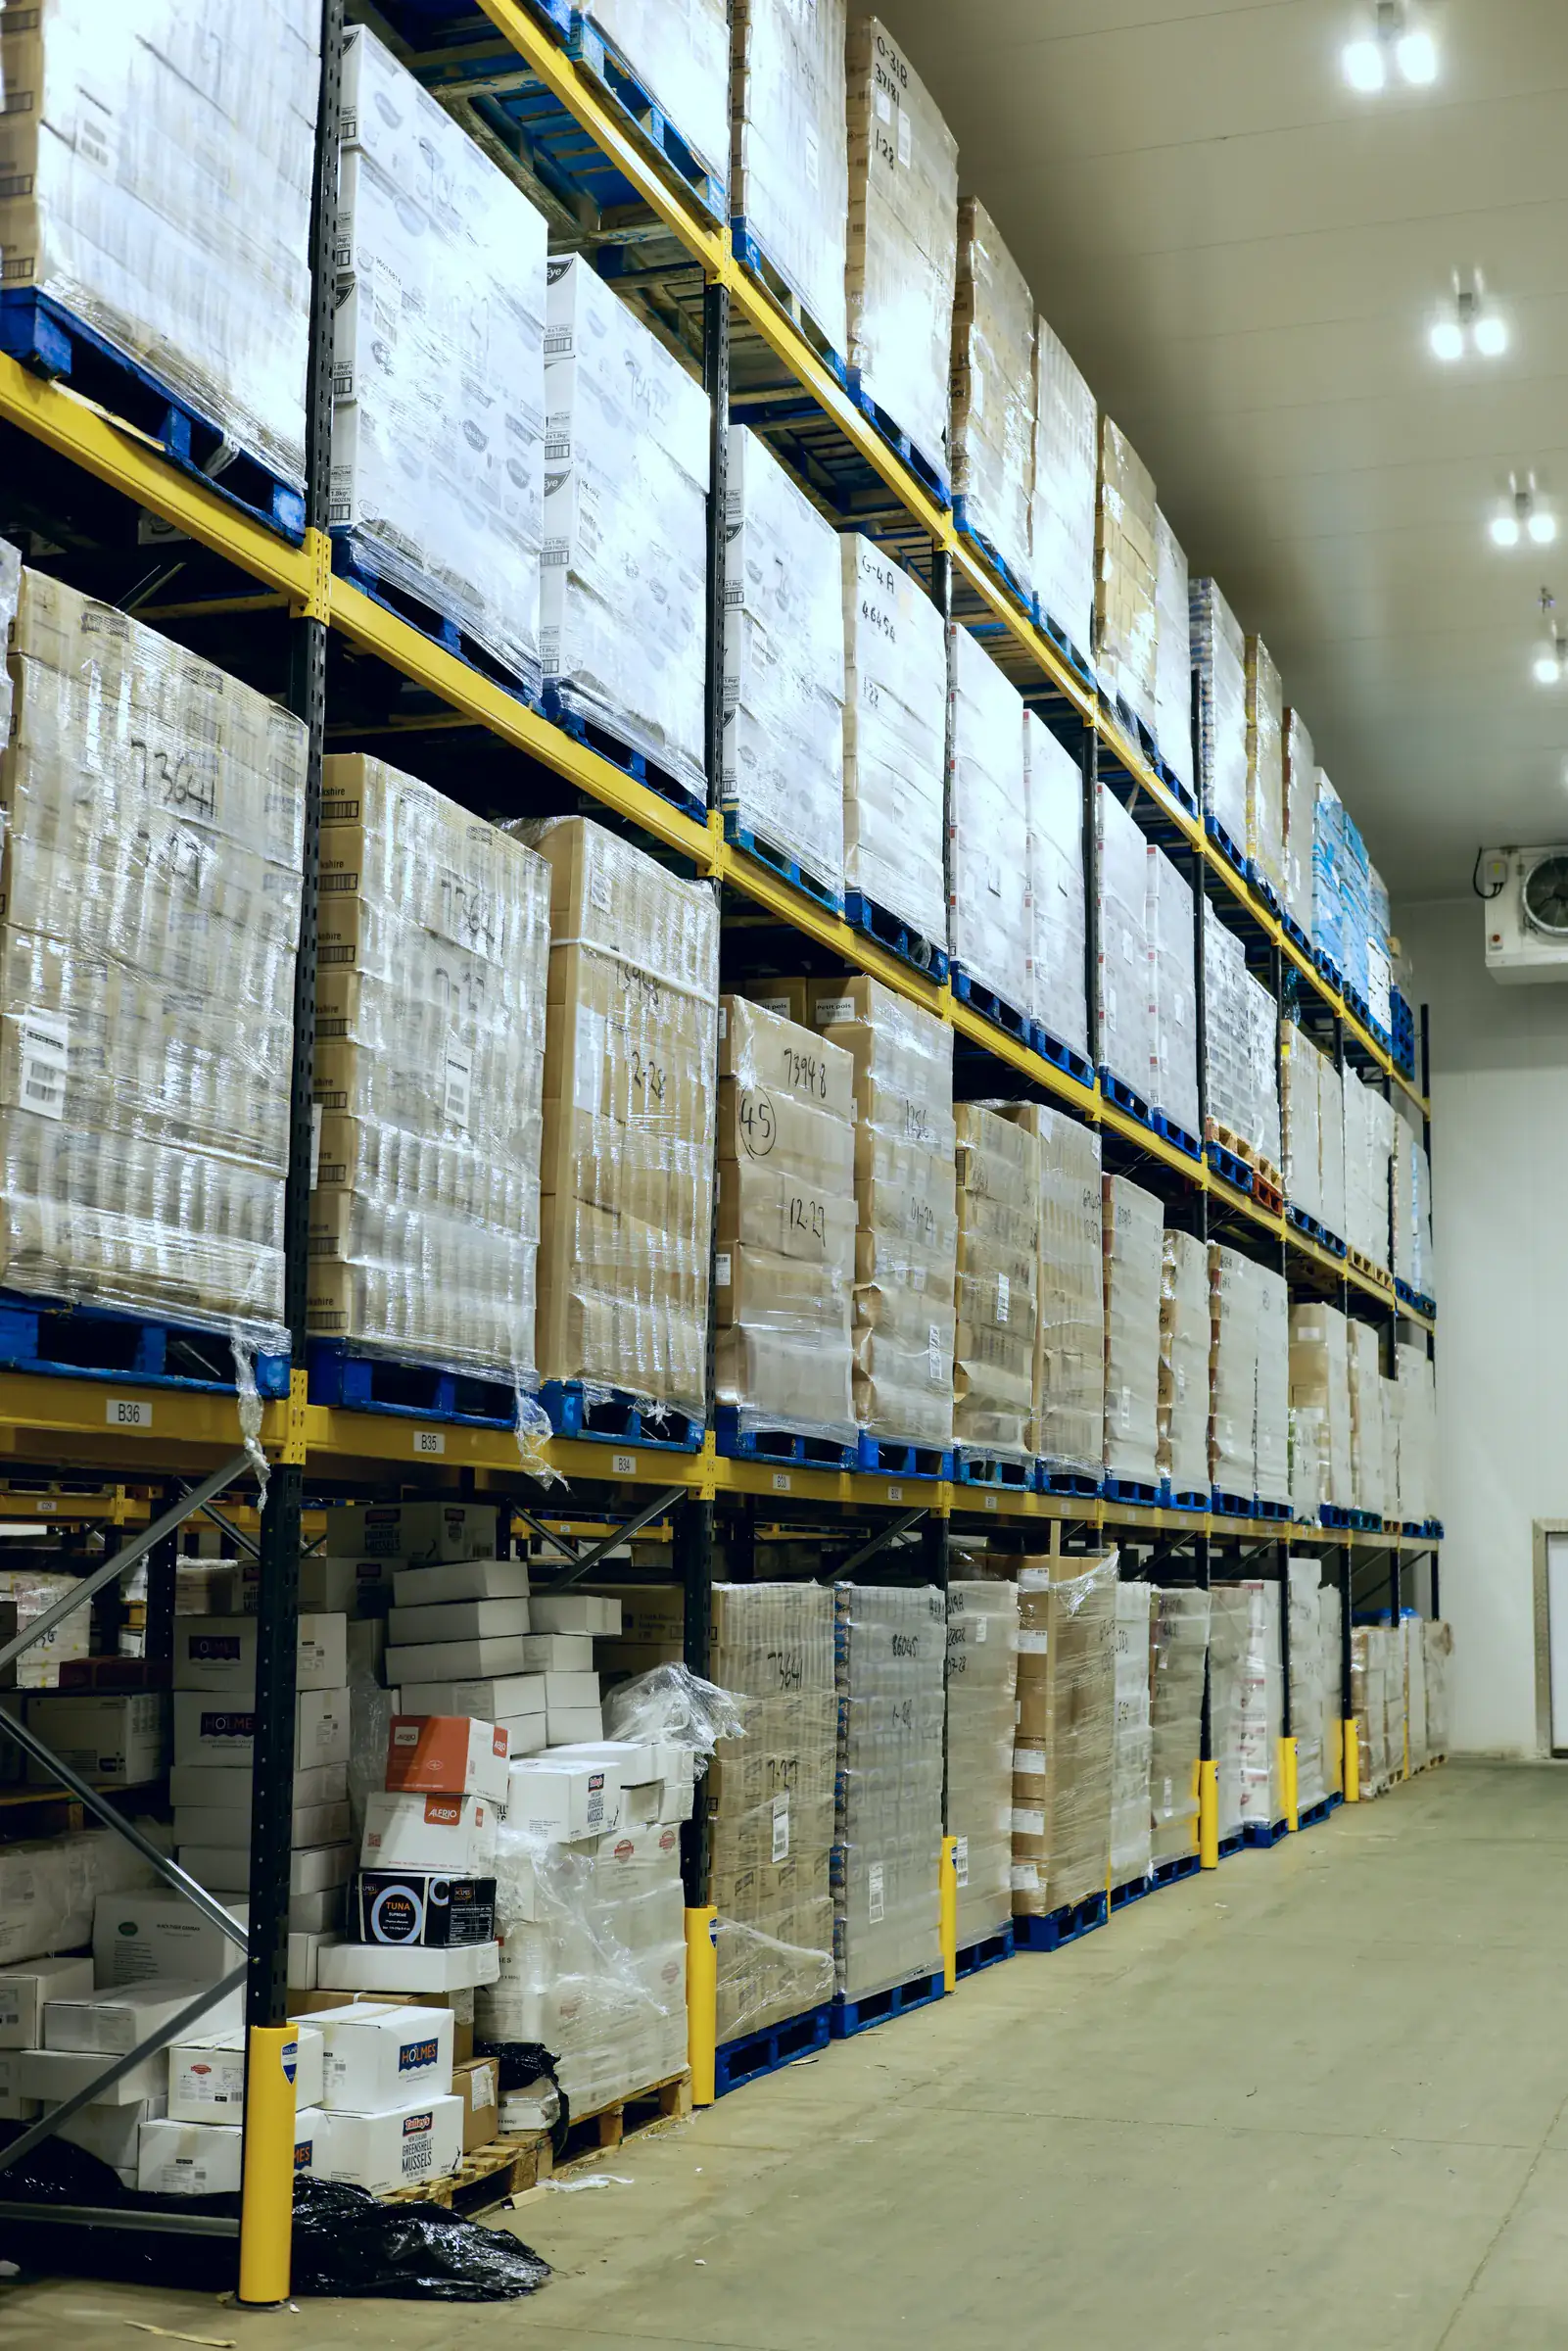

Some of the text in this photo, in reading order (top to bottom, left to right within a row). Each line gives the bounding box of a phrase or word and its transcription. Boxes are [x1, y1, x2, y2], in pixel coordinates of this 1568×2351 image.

[321, 787, 346, 796] kshire
[319, 859, 345, 870] kshire
[784, 1047, 827, 1099] 73948
[740, 1098, 771, 1138] 45
[118, 1403, 140, 1422] B36
[421, 1434, 437, 1451] B35
[618, 1457, 631, 1471] B34
[767, 1651, 803, 1690] 73641
[204, 1716, 254, 1731] HOLME
[428, 1806, 457, 1819] ALERIO
[587, 1807, 604, 1824] MUSSELS
[385, 1901, 410, 1911] TUNA
[402, 2042, 436, 2064] HOLMES
[404, 2115, 431, 2132] Talley's
[294, 2146, 310, 2164] MES
[402, 2151, 432, 2174] MUSSELS
